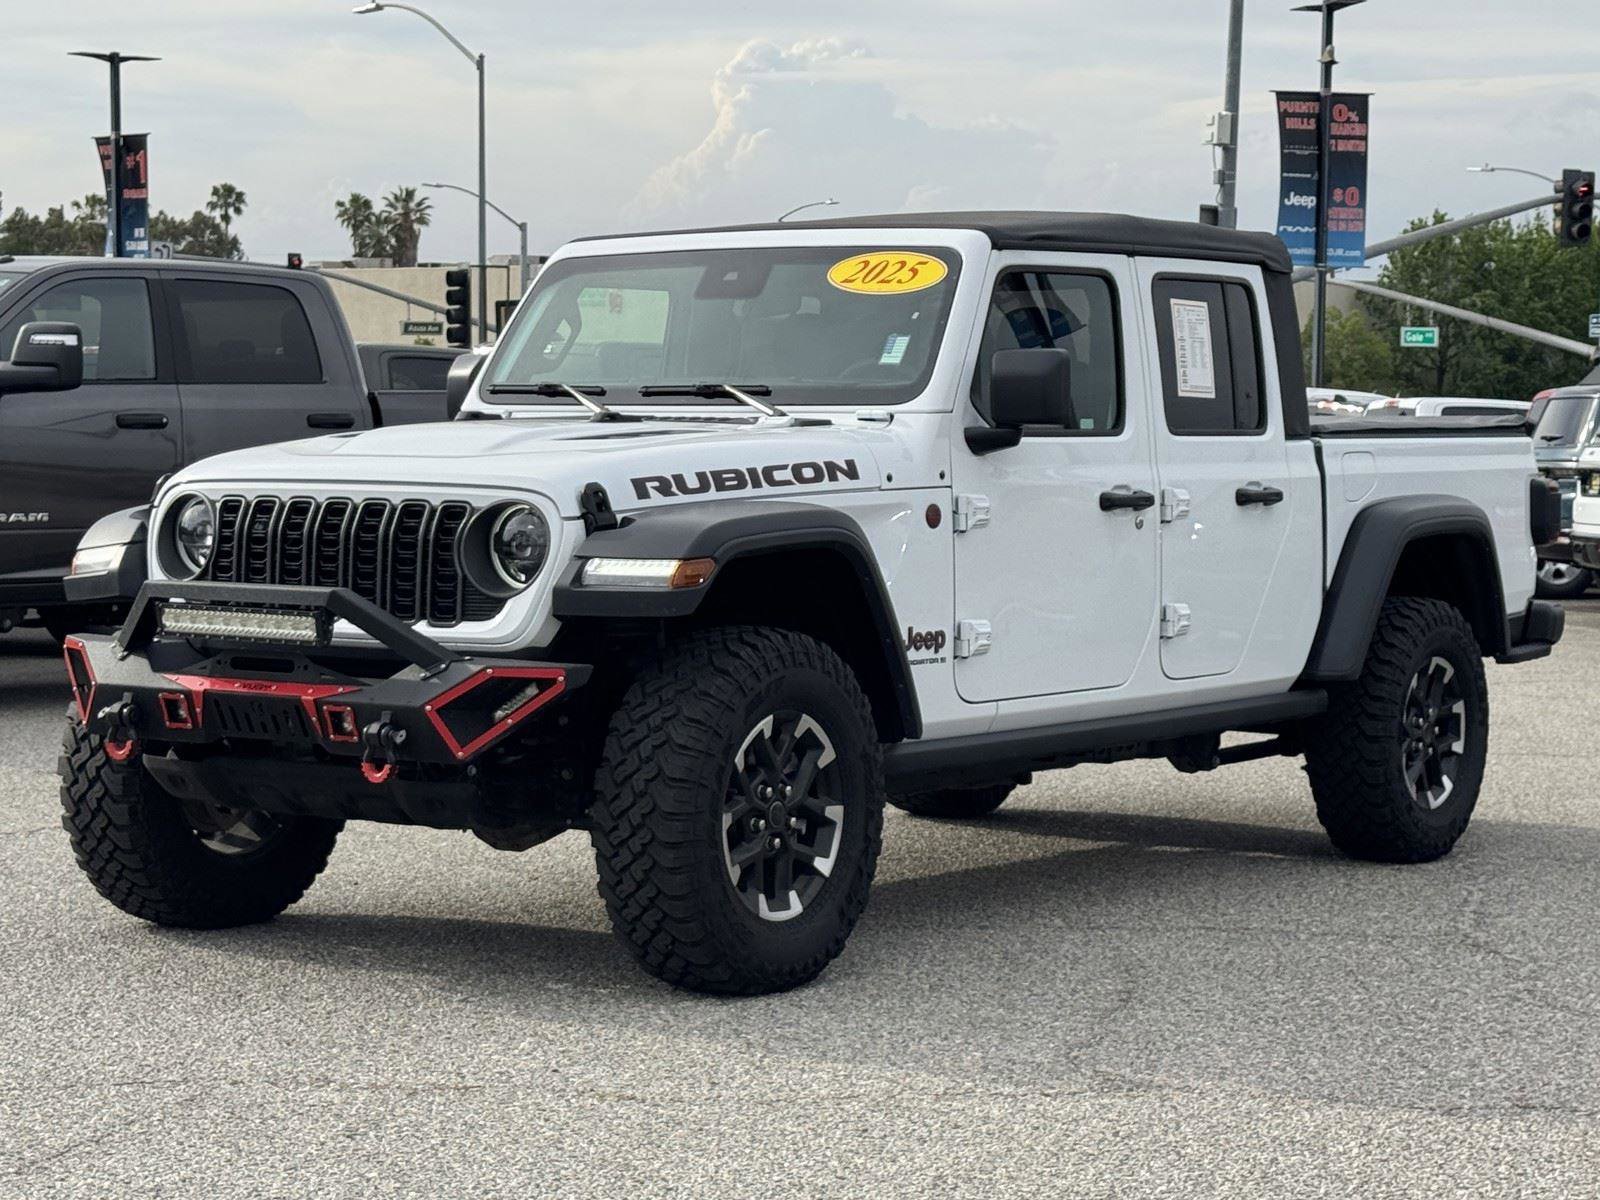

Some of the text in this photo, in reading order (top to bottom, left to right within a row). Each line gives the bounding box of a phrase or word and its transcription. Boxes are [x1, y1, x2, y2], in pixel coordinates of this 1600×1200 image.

[1332, 104, 1359, 122] 0%
[1285, 117, 1317, 130] HILLS
[1284, 191, 1317, 209] Jeep
[1332, 186, 1360, 207] $0
[840, 260, 929, 284] 2025
[1406, 331, 1424, 342] Gale
[630, 459, 860, 500] RUBICON
[904, 626, 946, 655] Jeep
